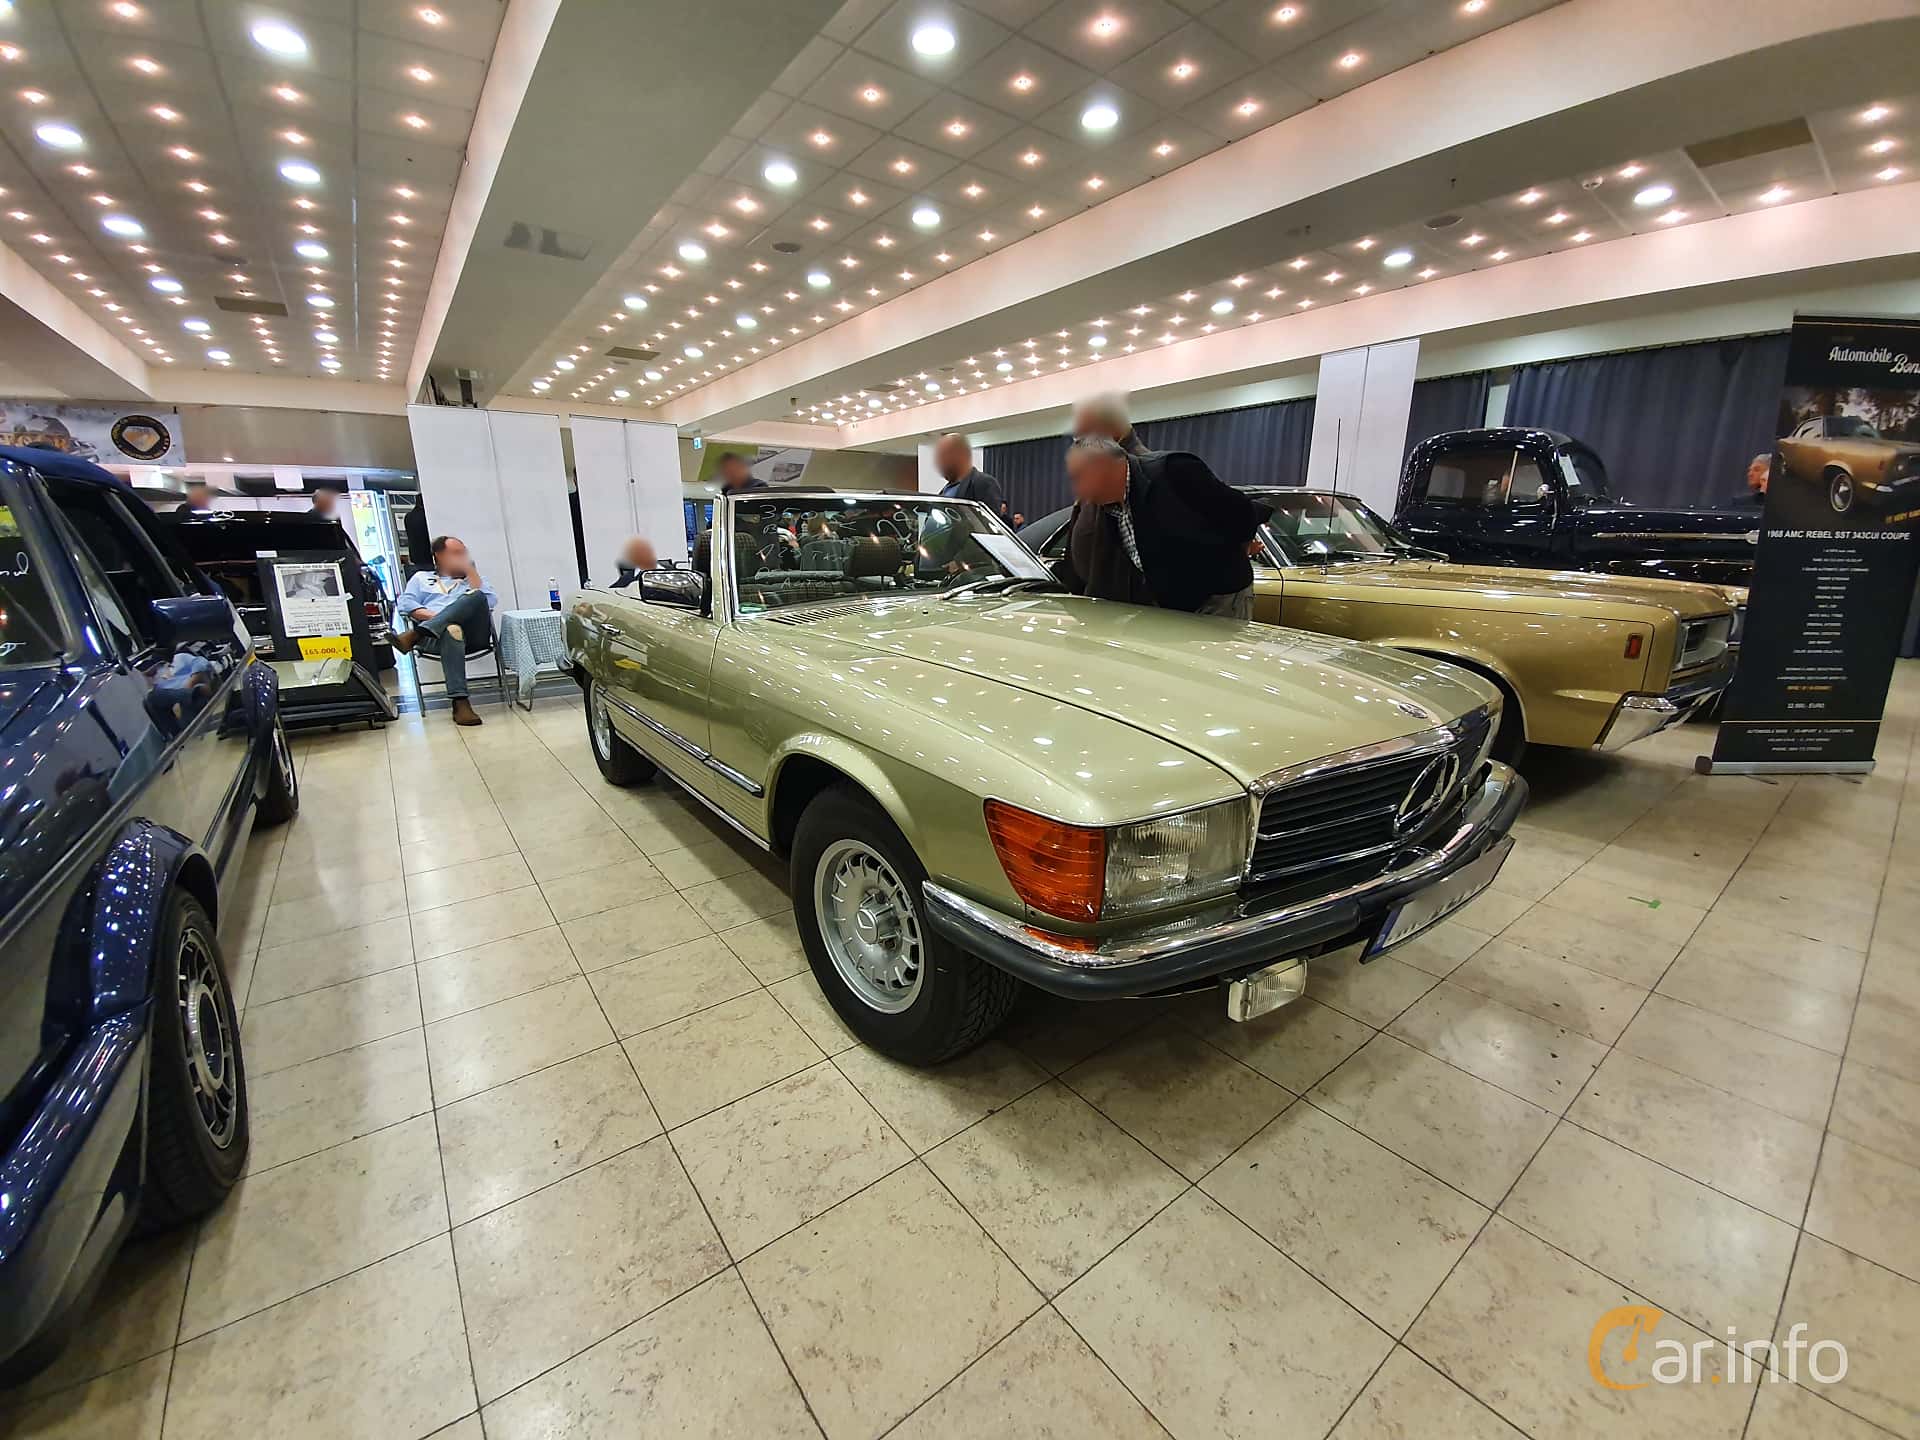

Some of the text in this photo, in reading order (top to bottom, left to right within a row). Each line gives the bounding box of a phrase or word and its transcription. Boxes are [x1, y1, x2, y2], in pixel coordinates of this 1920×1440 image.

[1828, 346, 1893, 363] Automobile
[1784, 530, 1804, 539] AMC
[1806, 530, 1833, 539] REBEL
[1835, 531, 1851, 540] SST
[1881, 532, 1911, 541] COUPE
